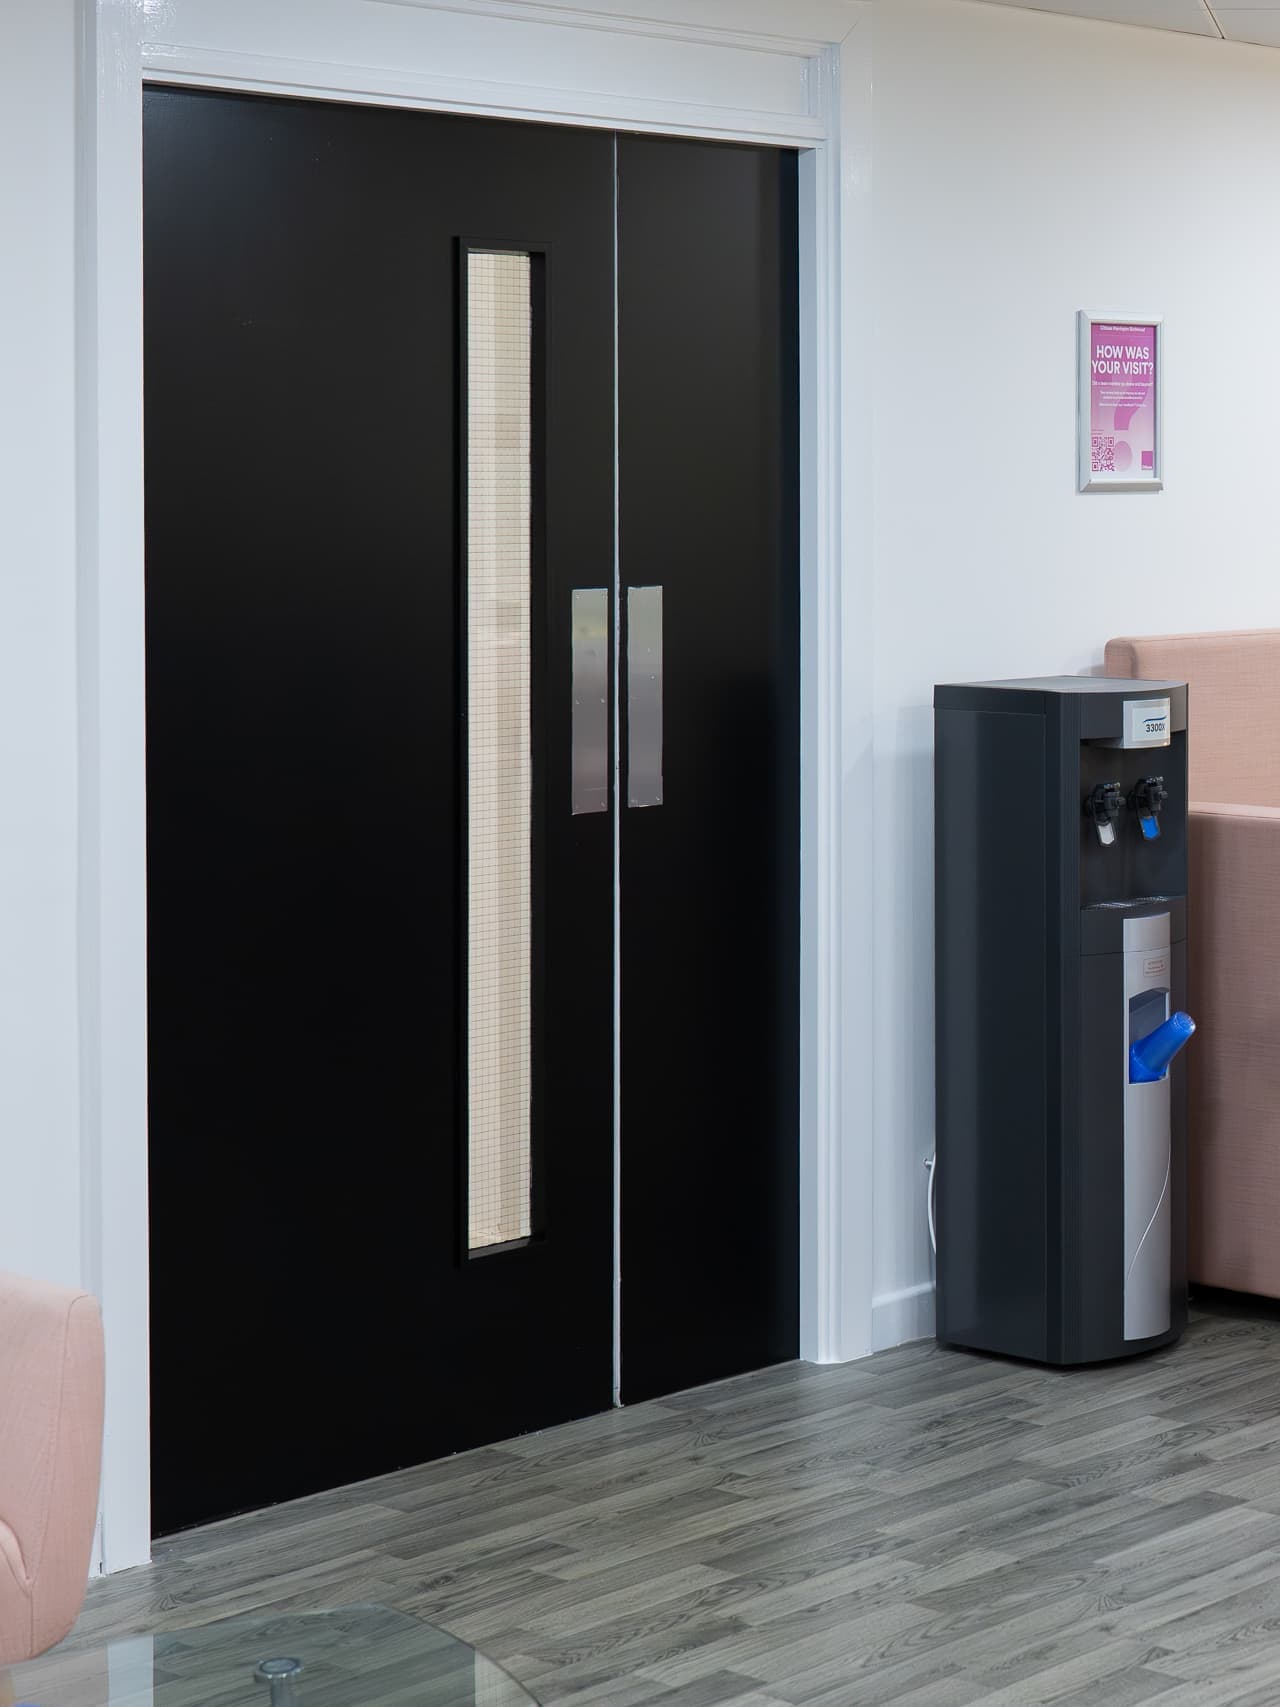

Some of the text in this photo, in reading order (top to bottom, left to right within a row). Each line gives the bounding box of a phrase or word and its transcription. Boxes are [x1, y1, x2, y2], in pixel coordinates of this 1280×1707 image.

[1096, 345, 1149, 359] HOW WAS
[1092, 360, 1154, 375] YOUR VISIT?
